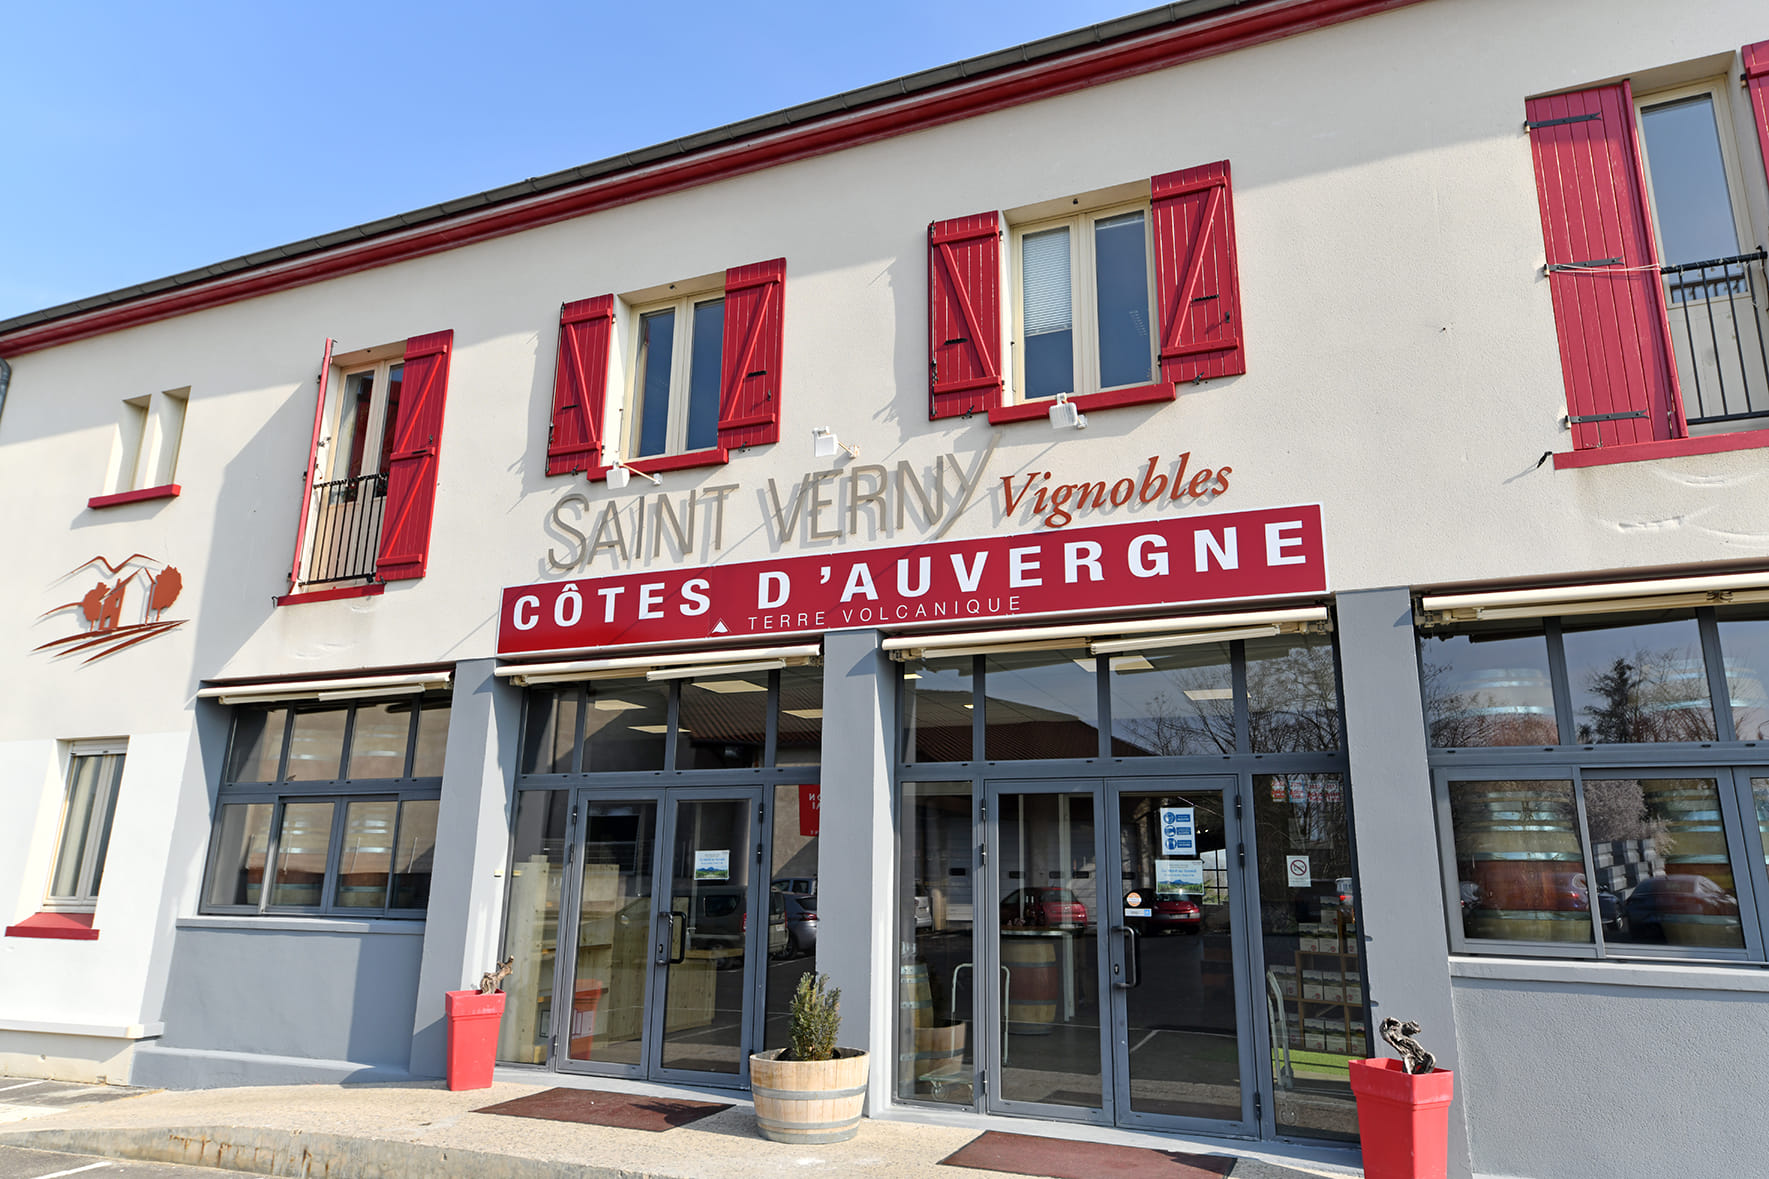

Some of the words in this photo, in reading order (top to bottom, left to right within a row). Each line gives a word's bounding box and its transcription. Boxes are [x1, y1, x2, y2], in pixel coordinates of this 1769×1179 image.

[548, 483, 740, 570] SAINT
[768, 434, 1002, 541] VERNY
[1000, 451, 1233, 529] Vignobles
[512, 578, 711, 631] CÔTES
[748, 610, 825, 630] TERRE
[842, 595, 1021, 622] VOLCANIQUE
